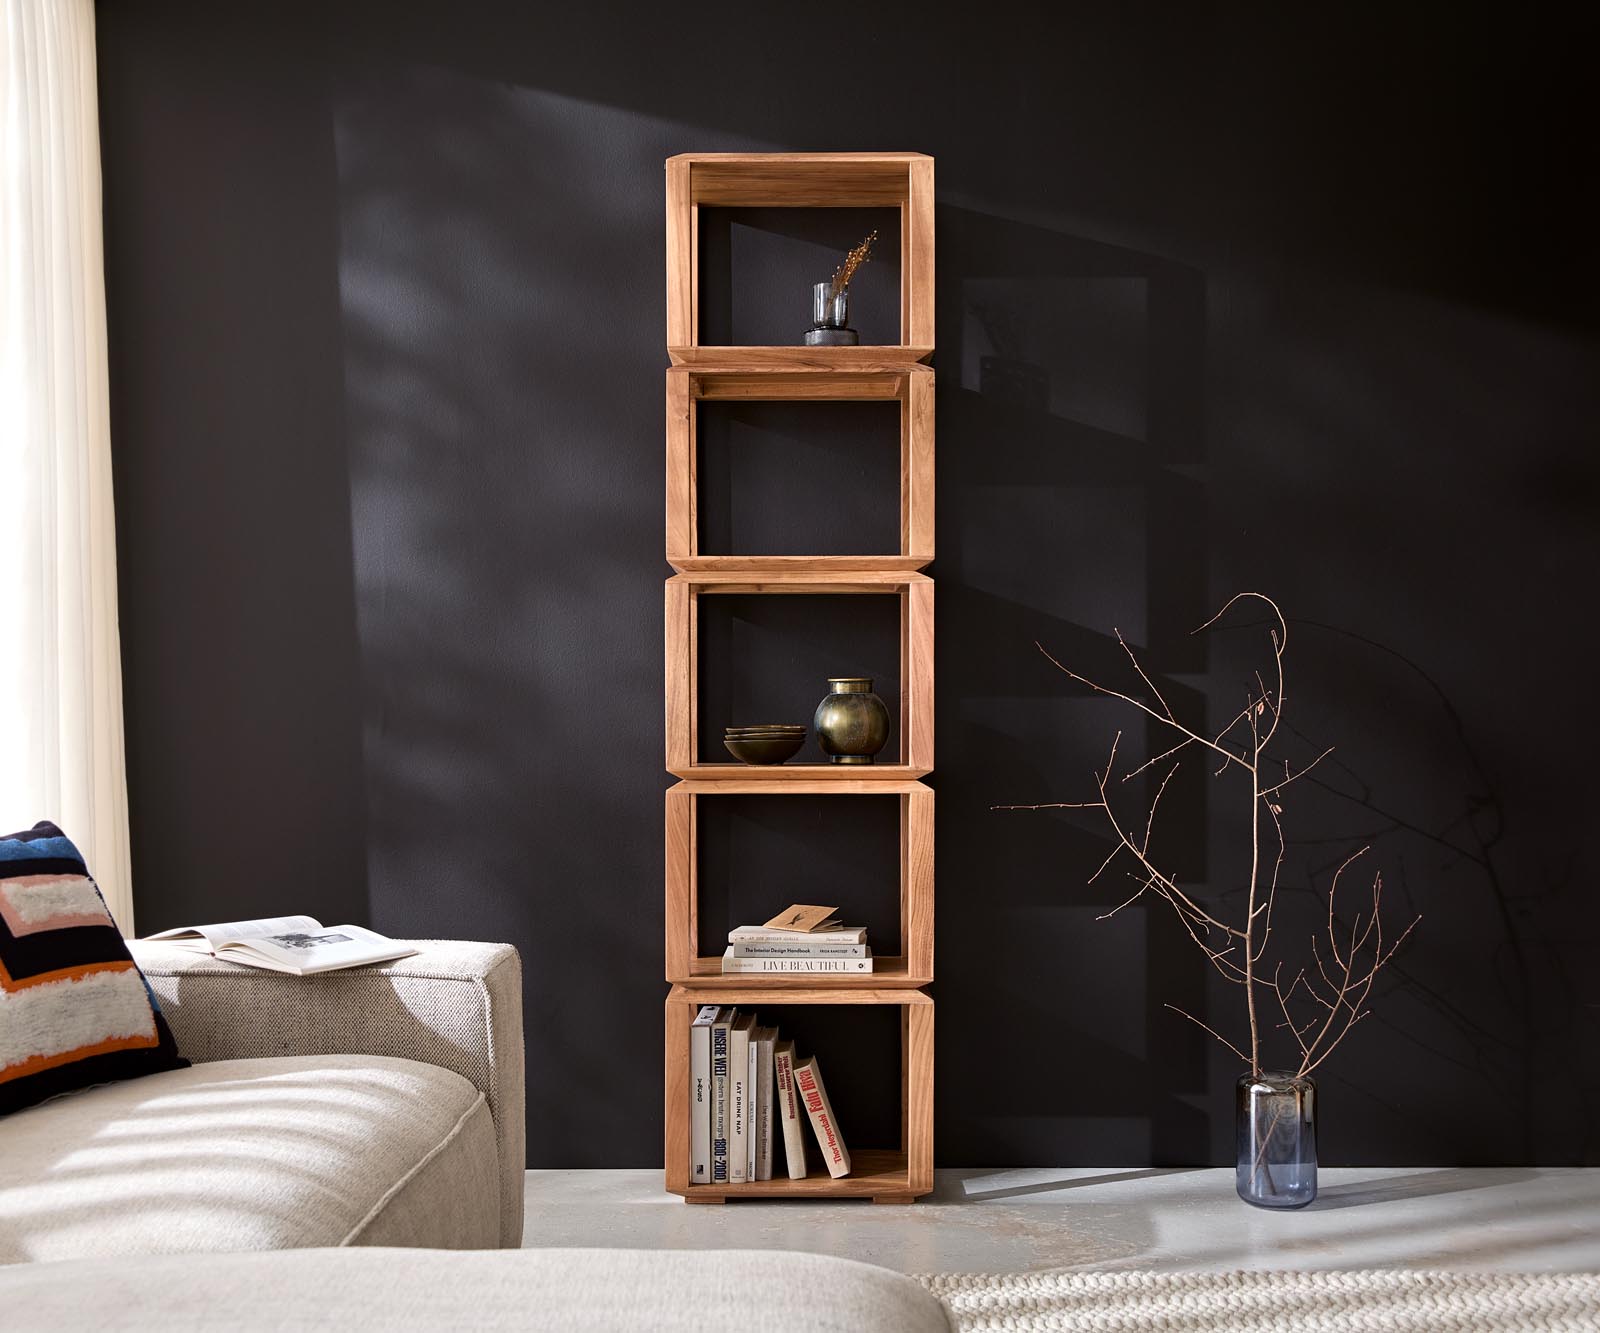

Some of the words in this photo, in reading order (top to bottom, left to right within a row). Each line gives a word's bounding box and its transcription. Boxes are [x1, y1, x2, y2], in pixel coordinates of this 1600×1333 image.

[763, 961, 787, 971] LIVE
[790, 961, 849, 971] BEAUTIFUL
[714, 1028, 727, 1056] UNSERE
[714, 1057, 727, 1077] WELT
[798, 1069, 816, 1092] Hiva
[818, 1113, 836, 1147] Heyerdahl
[714, 1138, 727, 1180] 1800-2000
[831, 1147, 842, 1164] Thor
